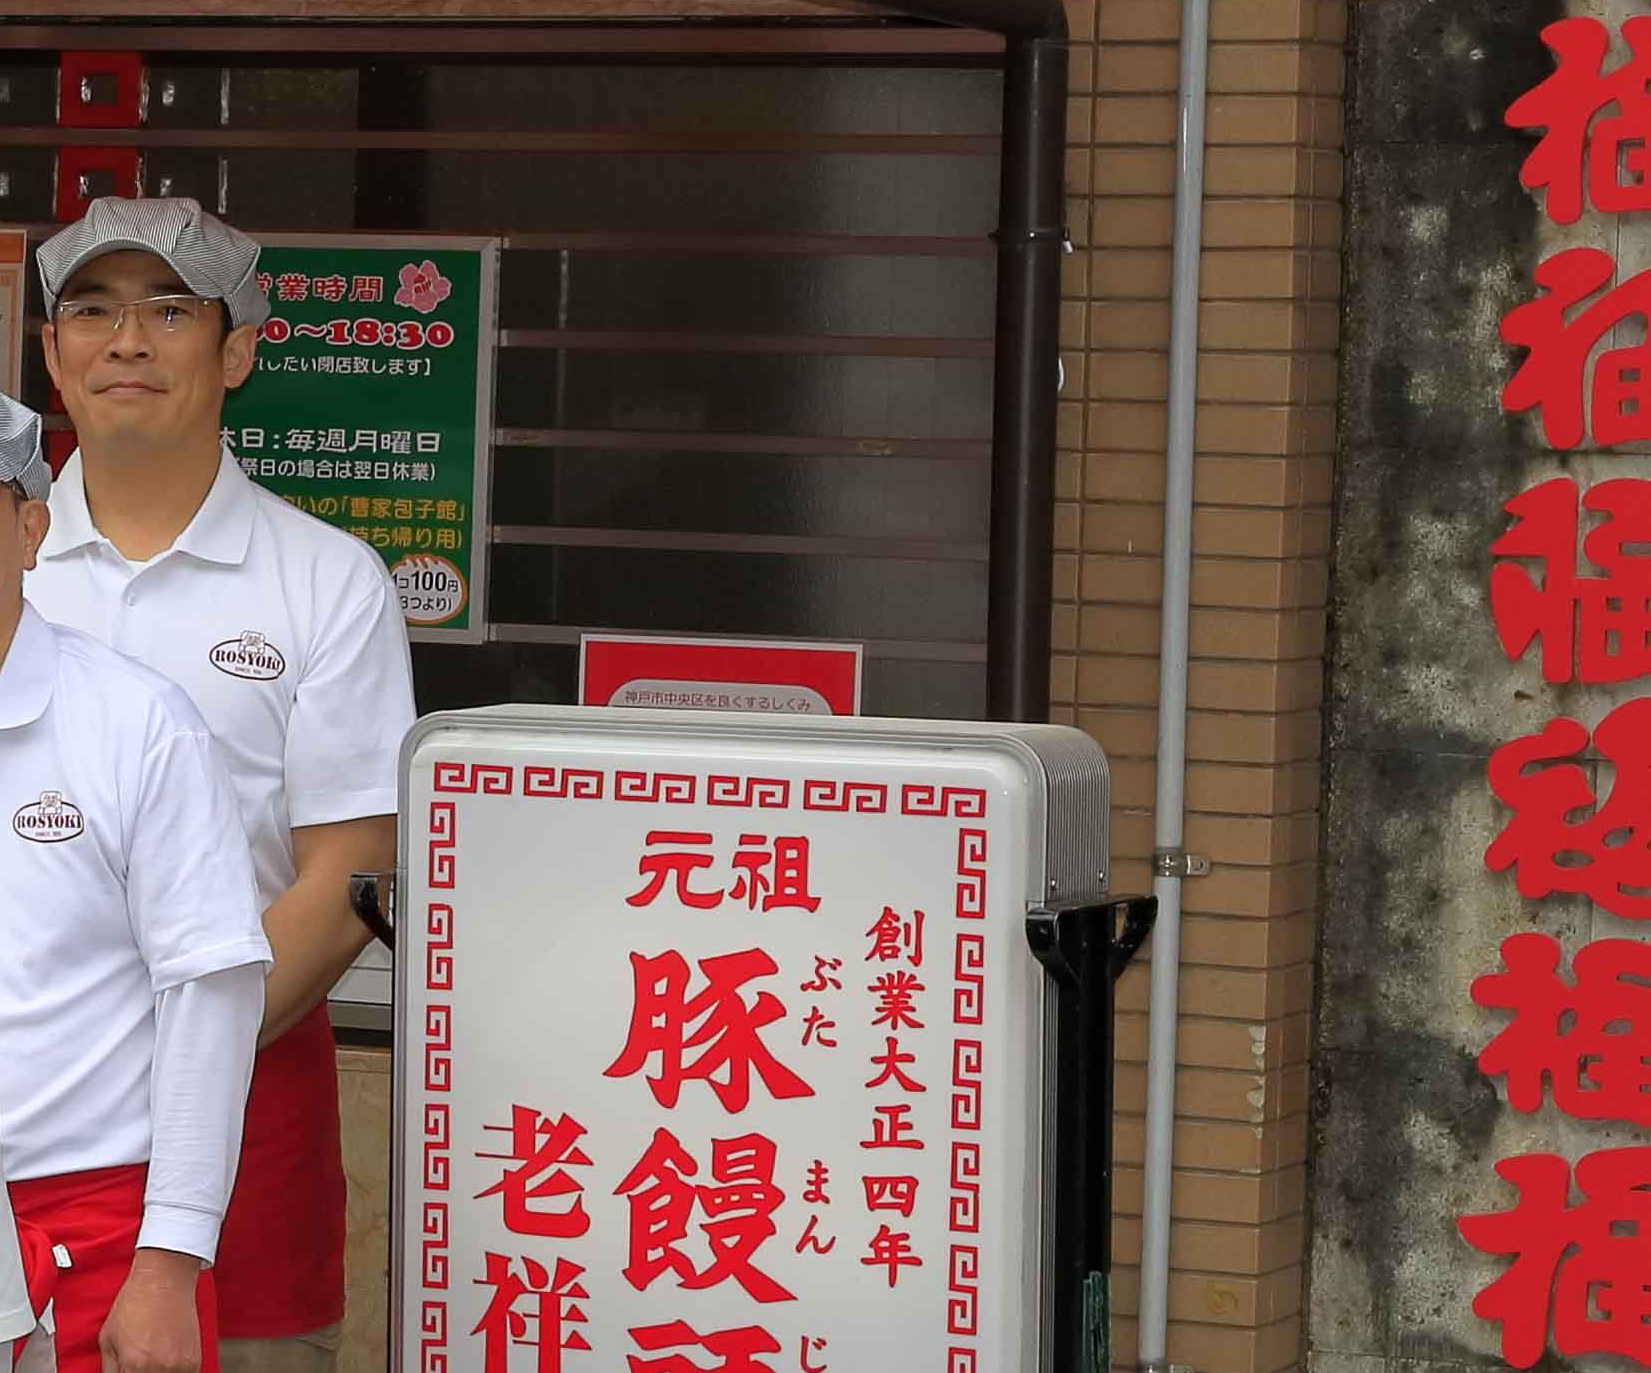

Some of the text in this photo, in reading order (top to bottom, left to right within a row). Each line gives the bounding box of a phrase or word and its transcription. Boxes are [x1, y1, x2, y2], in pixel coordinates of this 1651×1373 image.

[17, 814, 81, 829] ROSYOKI
[627, 831, 822, 913] 元祖
[861, 907, 927, 1287] 創業大正四年
